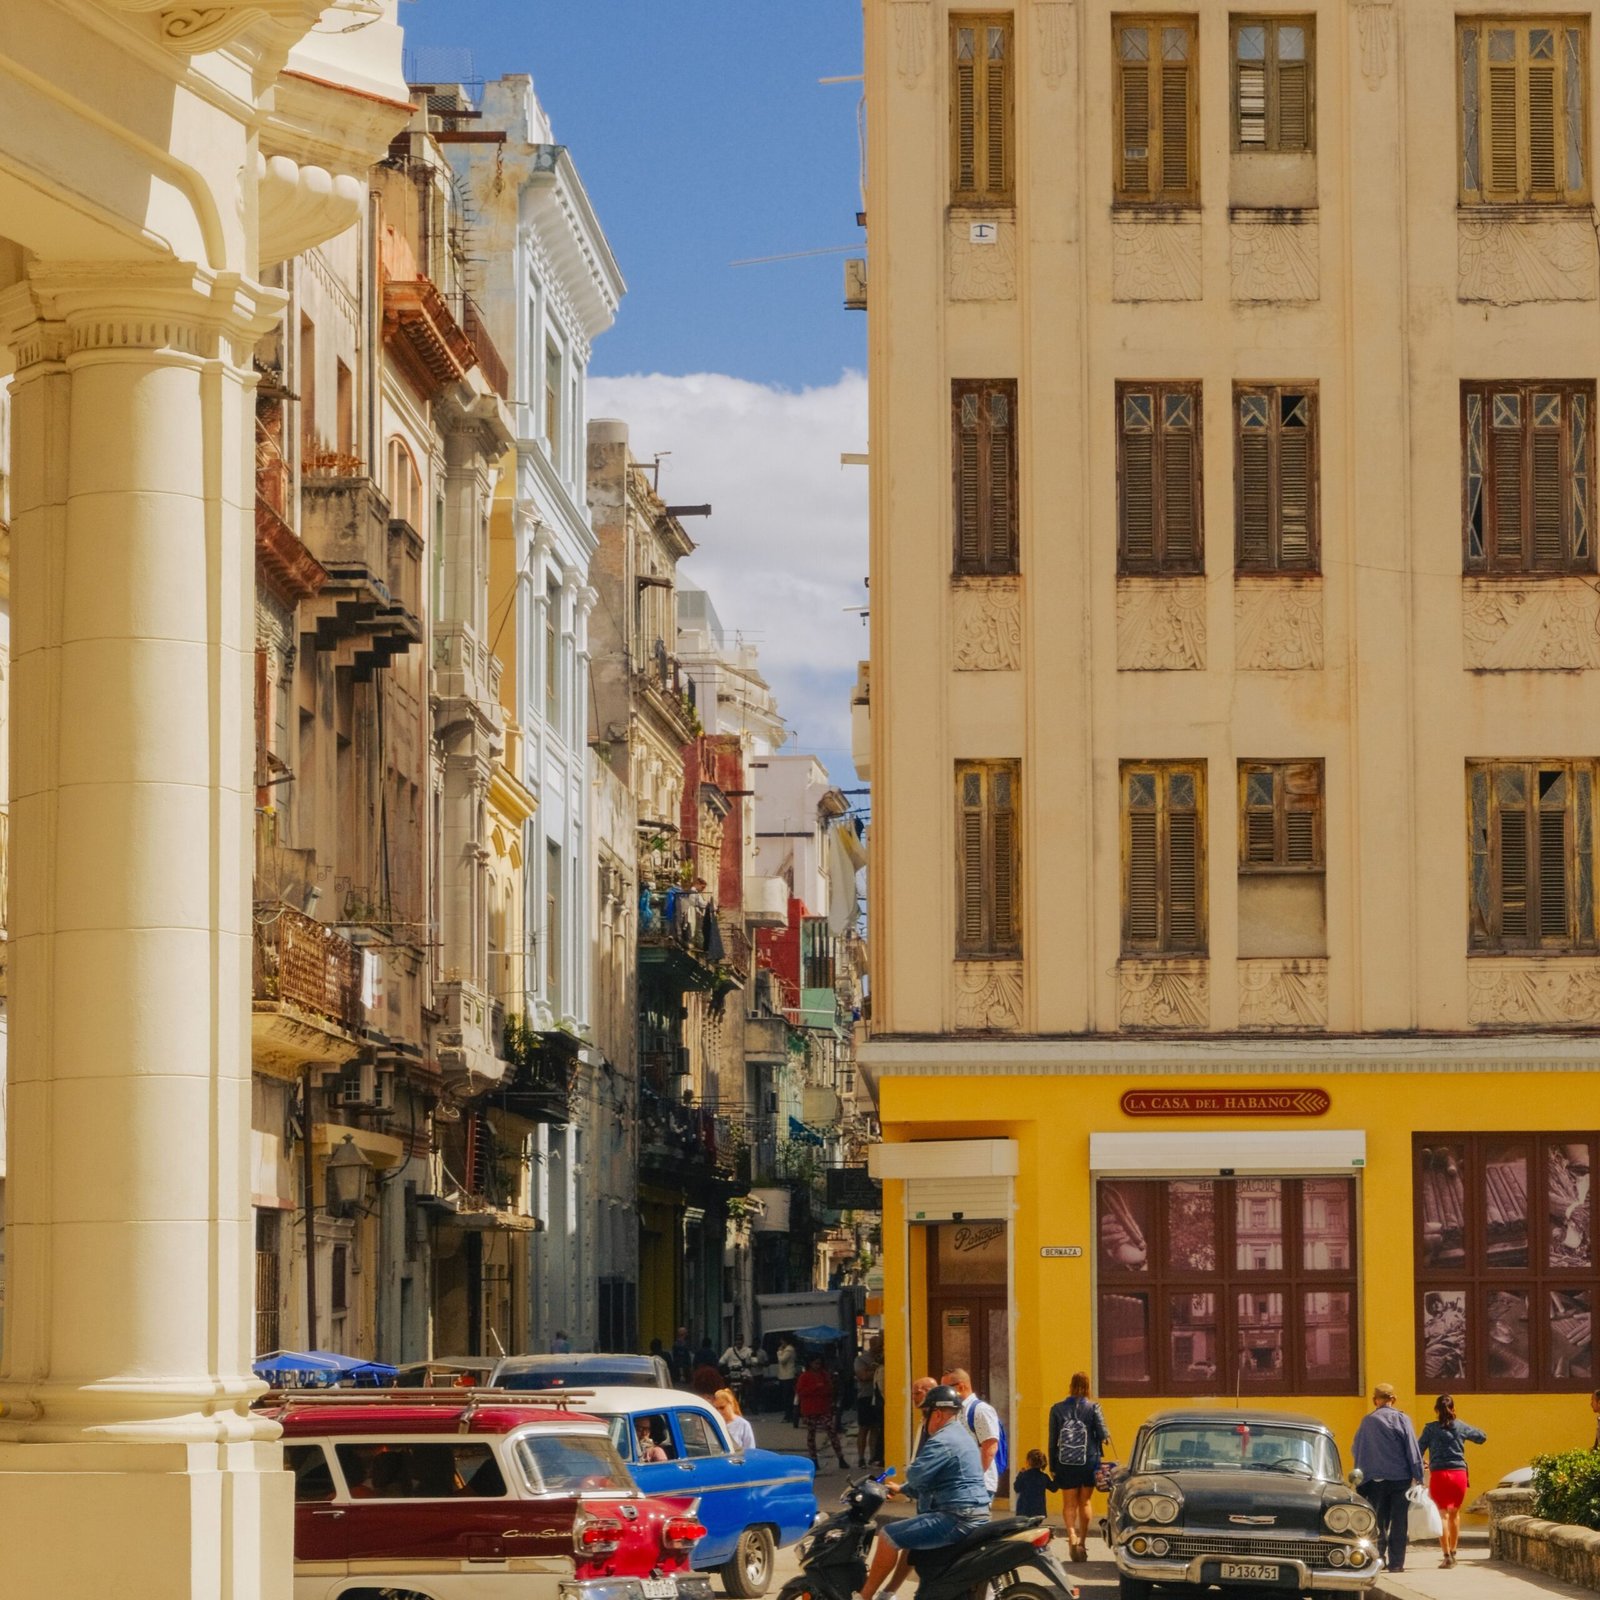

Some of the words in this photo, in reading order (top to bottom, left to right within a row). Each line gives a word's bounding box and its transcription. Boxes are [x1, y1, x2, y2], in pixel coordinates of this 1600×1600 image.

[1130, 1099, 1147, 1109] LA
[1151, 1098, 1190, 1109] CASA
[1196, 1099, 1220, 1109] DEL
[1224, 1097, 1291, 1109] HABANO
[1045, 1248, 1078, 1256] BERNAZA
[1228, 1564, 1277, 1579] P136751
